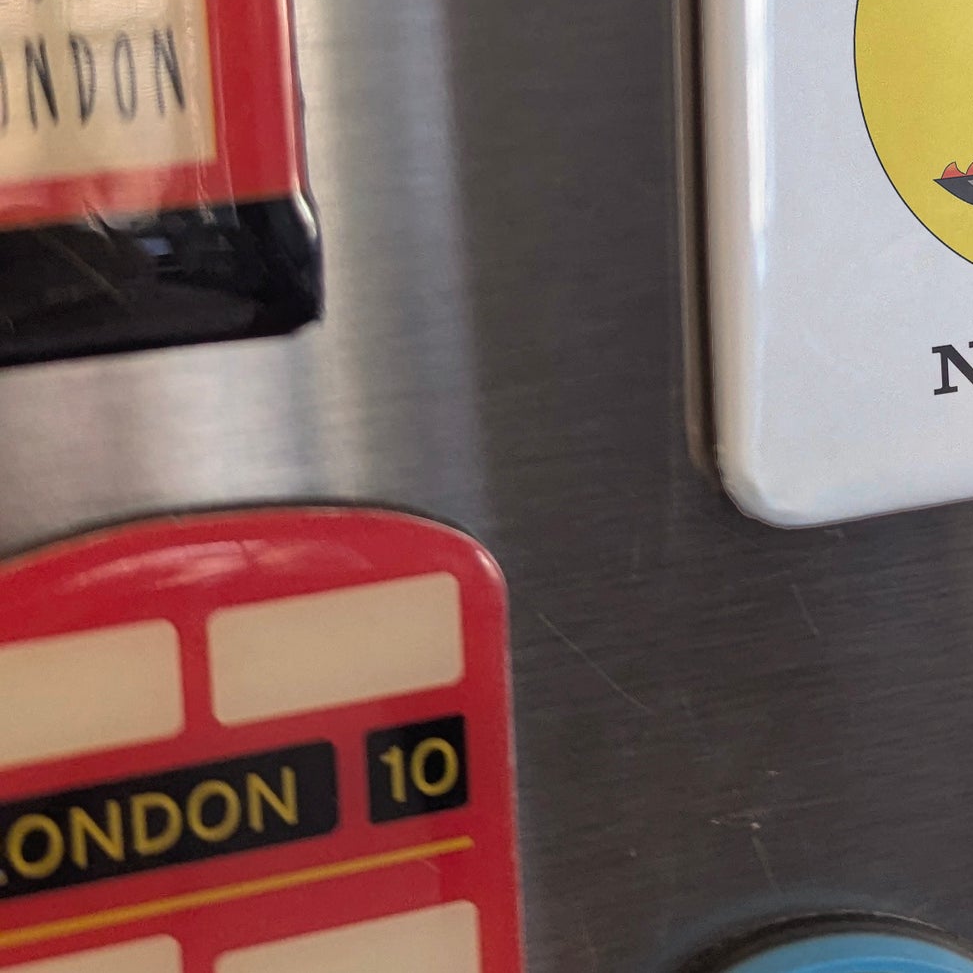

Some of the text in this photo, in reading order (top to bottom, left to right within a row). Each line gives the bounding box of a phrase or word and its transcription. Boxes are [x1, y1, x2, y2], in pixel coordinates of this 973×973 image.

[0, 25, 186, 133] NDON
[0, 737, 460, 887] ONDON 10
